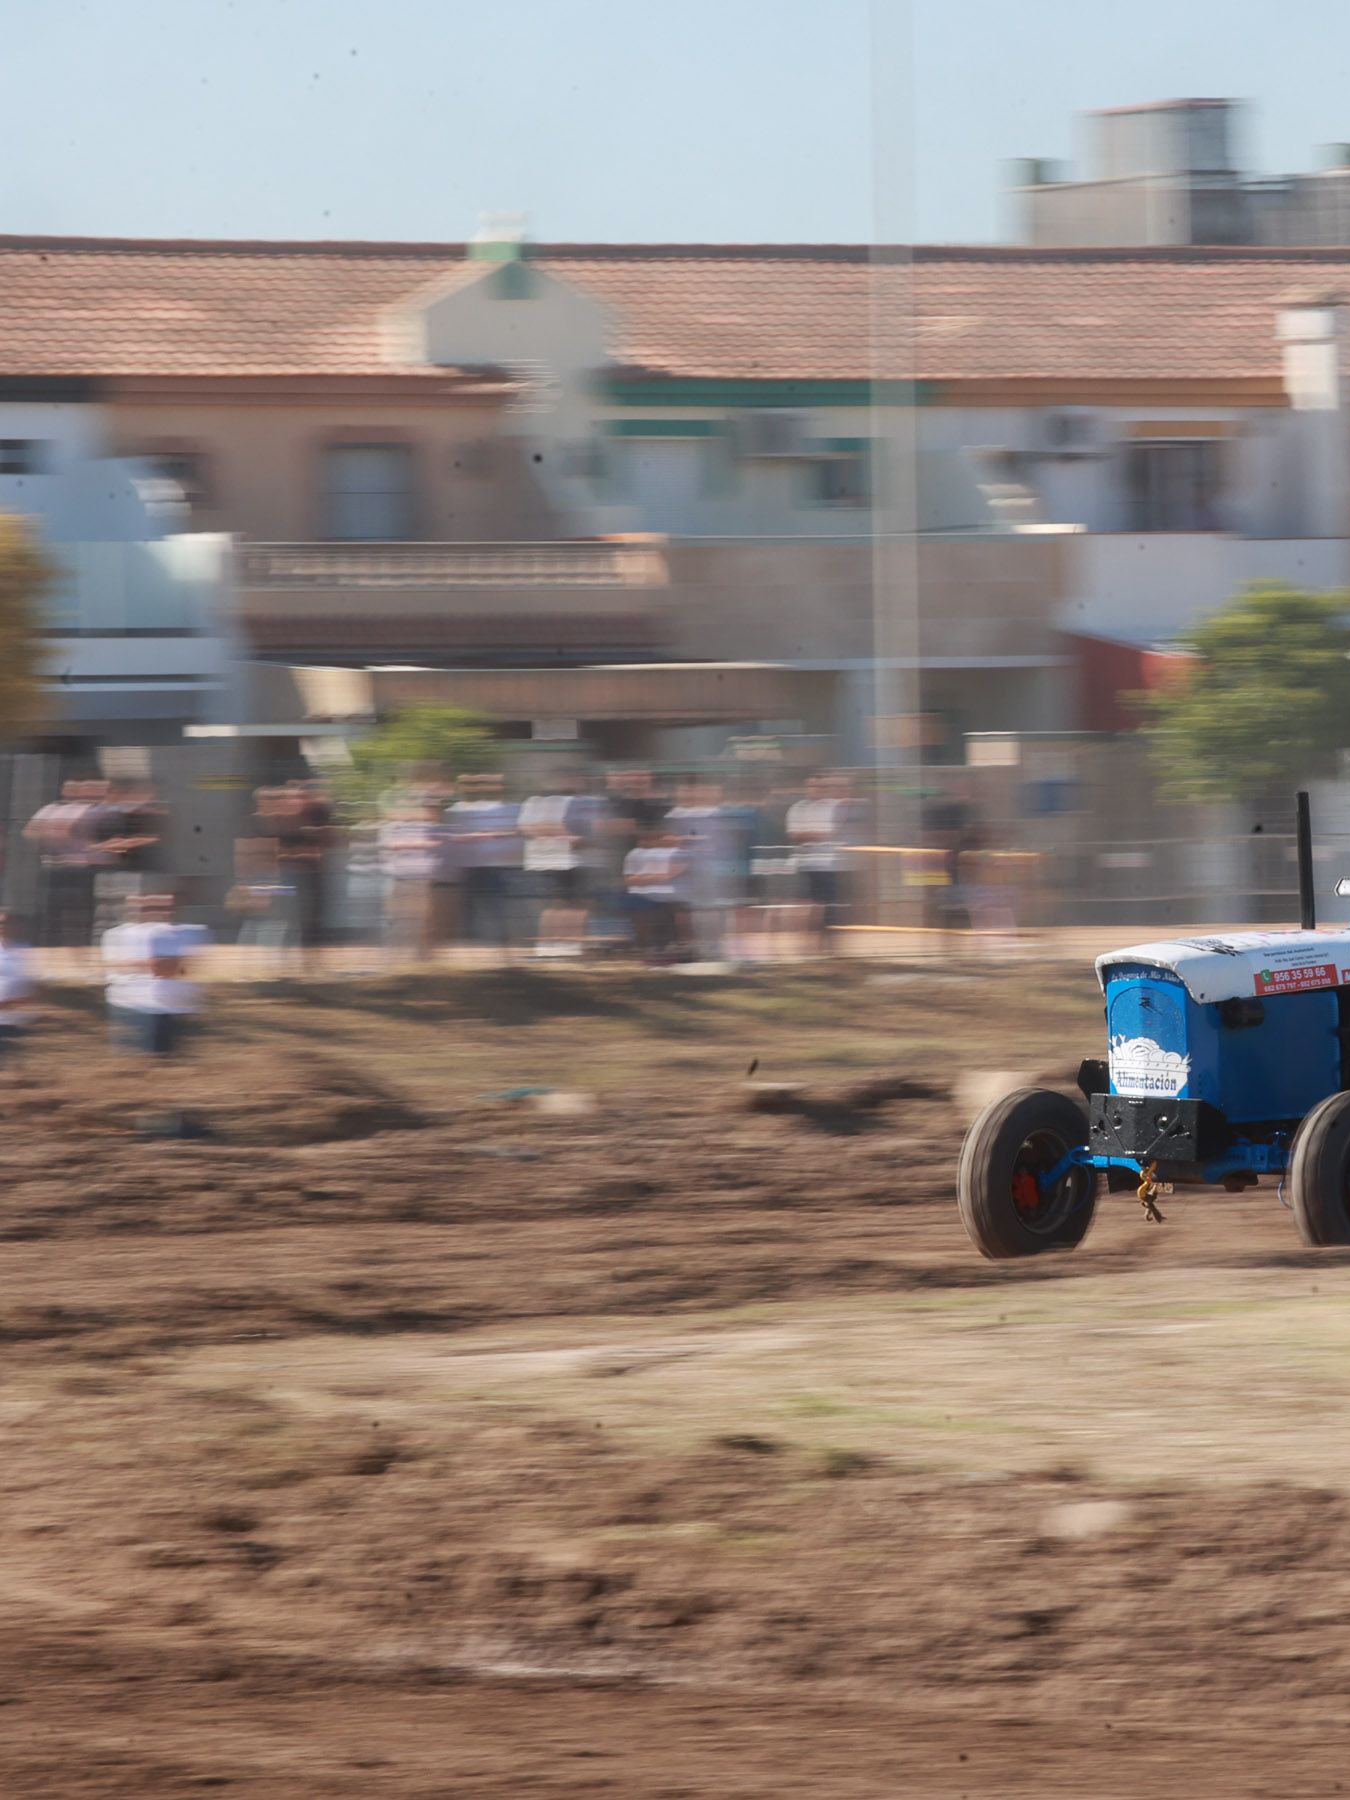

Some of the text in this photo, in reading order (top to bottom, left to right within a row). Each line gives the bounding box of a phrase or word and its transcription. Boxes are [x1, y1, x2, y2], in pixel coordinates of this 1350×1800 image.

[1273, 966, 1327, 982] 956 35 59 66
[1115, 1070, 1177, 1091] Alimentación
